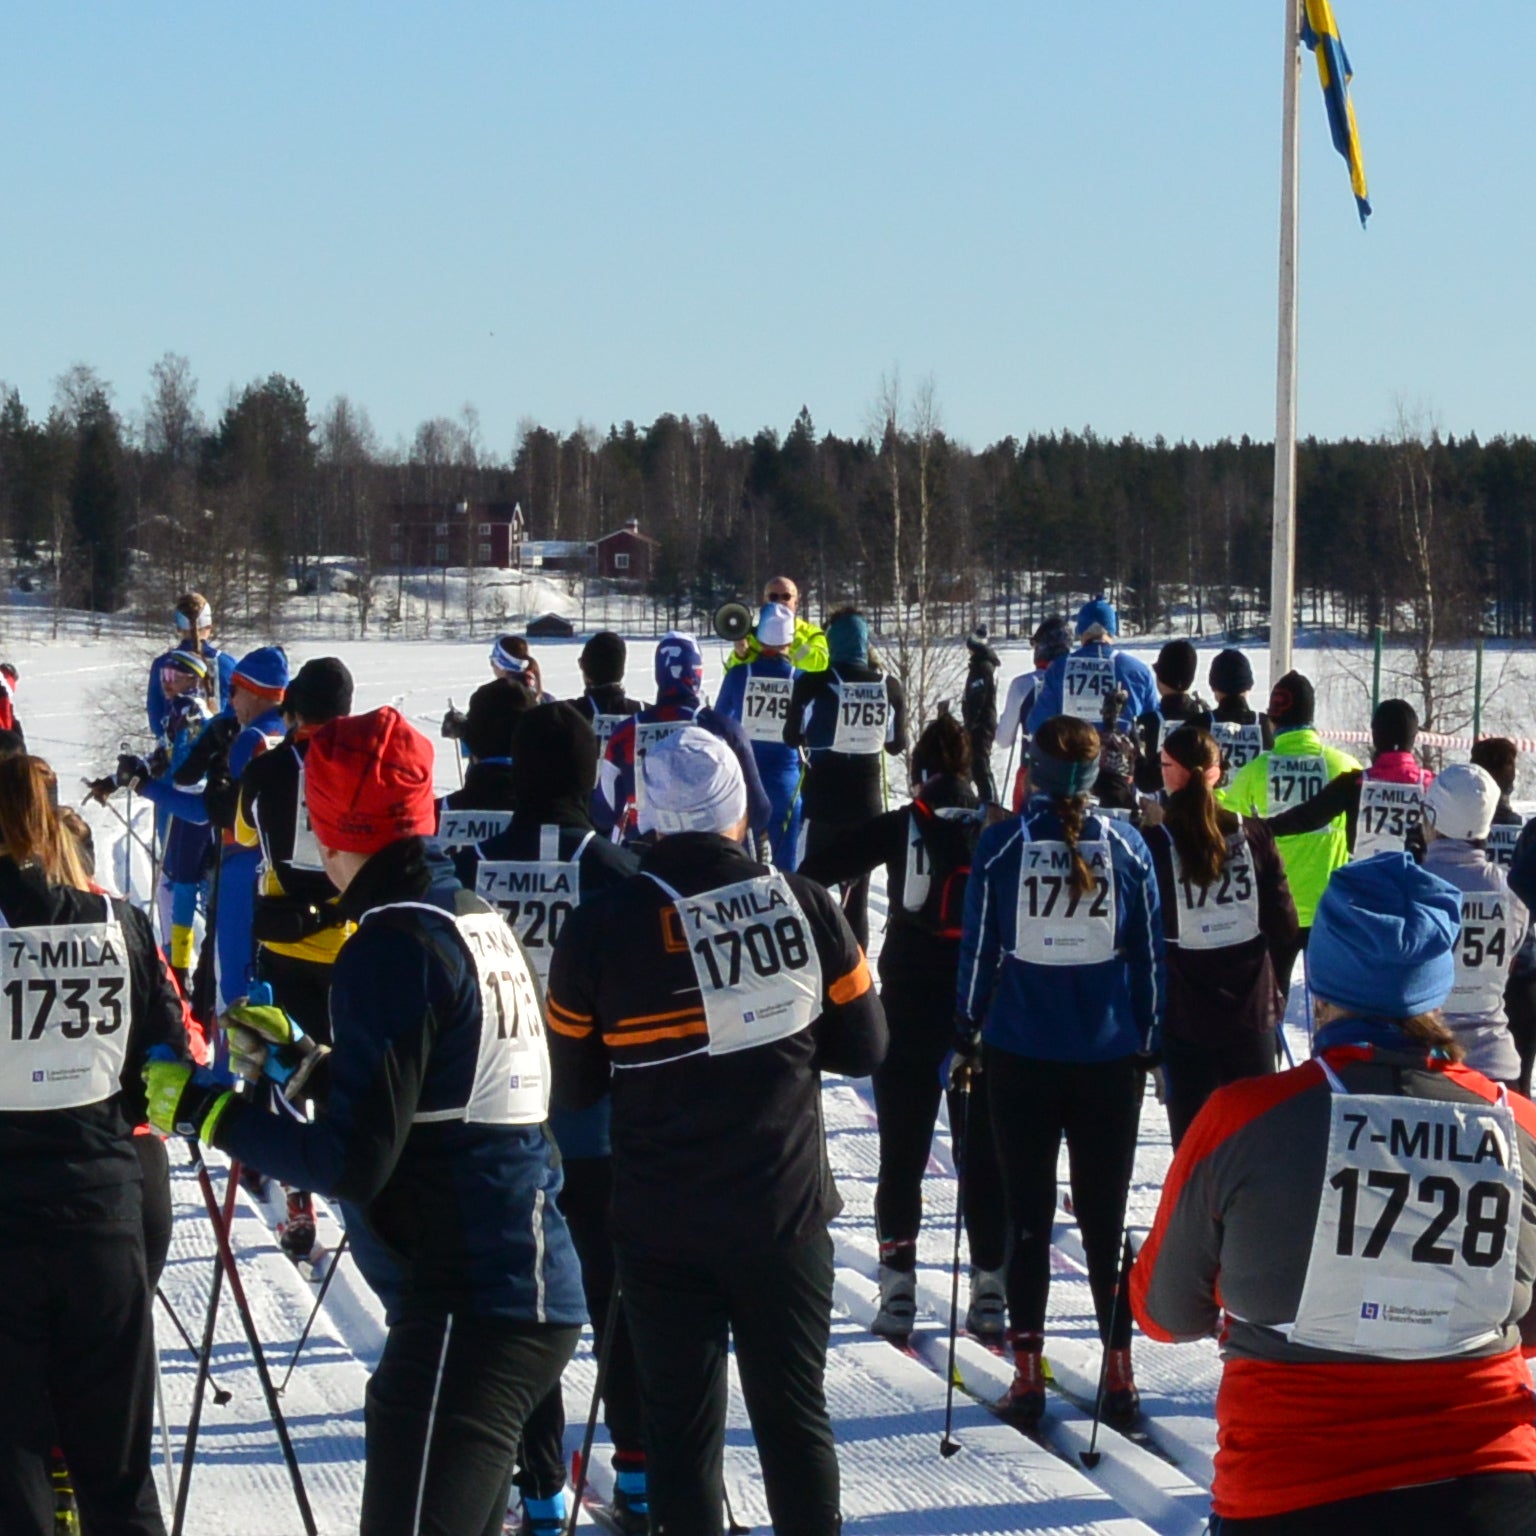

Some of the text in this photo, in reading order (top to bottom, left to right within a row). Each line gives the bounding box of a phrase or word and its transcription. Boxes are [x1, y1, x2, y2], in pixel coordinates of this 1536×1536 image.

[1070, 659, 1111, 673] 7-MILA
[749, 681, 790, 694] 7-MILA
[844, 687, 885, 700] 7-MILA
[1066, 674, 1113, 696] 1745
[746, 695, 791, 719] 1749
[842, 702, 887, 727] 1763
[1221, 743, 1261, 768] 757
[1272, 760, 1322, 773] 7-MILA
[1367, 787, 1421, 804] 7-MILA
[1028, 850, 1106, 869] 7-MA
[484, 872, 571, 894] 7-MILA
[687, 888, 789, 930] 7-MILA
[1023, 875, 1109, 918] 1772
[488, 899, 573, 949] 720
[8, 940, 121, 968] 7-MILA
[694, 915, 810, 990] 1708
[1453, 926, 1507, 968] 54
[2, 977, 125, 1041] 1733
[1342, 1113, 1505, 1167] 7-MILA
[1329, 1166, 1511, 1269] 1728
